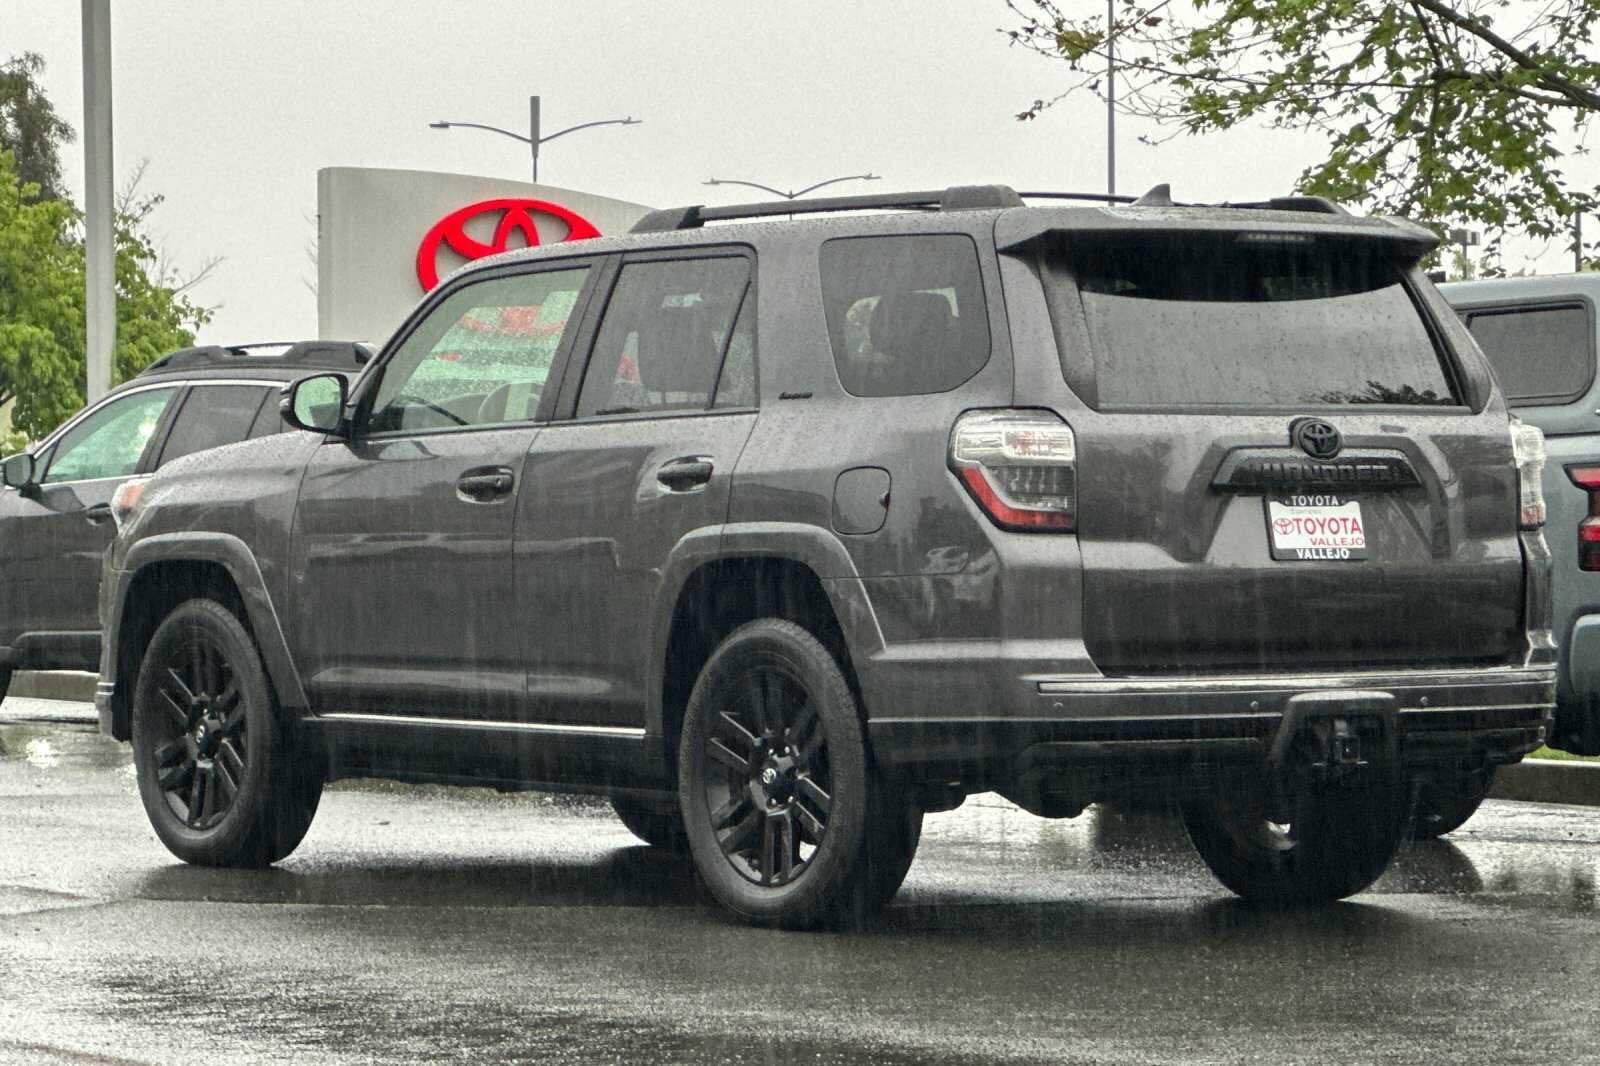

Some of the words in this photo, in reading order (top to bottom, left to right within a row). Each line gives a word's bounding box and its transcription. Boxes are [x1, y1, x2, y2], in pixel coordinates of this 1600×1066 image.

[1291, 495, 1340, 506] TOYOTA
[1292, 517, 1362, 535] TOYOTA
[1310, 537, 1364, 546] VALLEJO
[1296, 548, 1350, 559] VALLEJO
